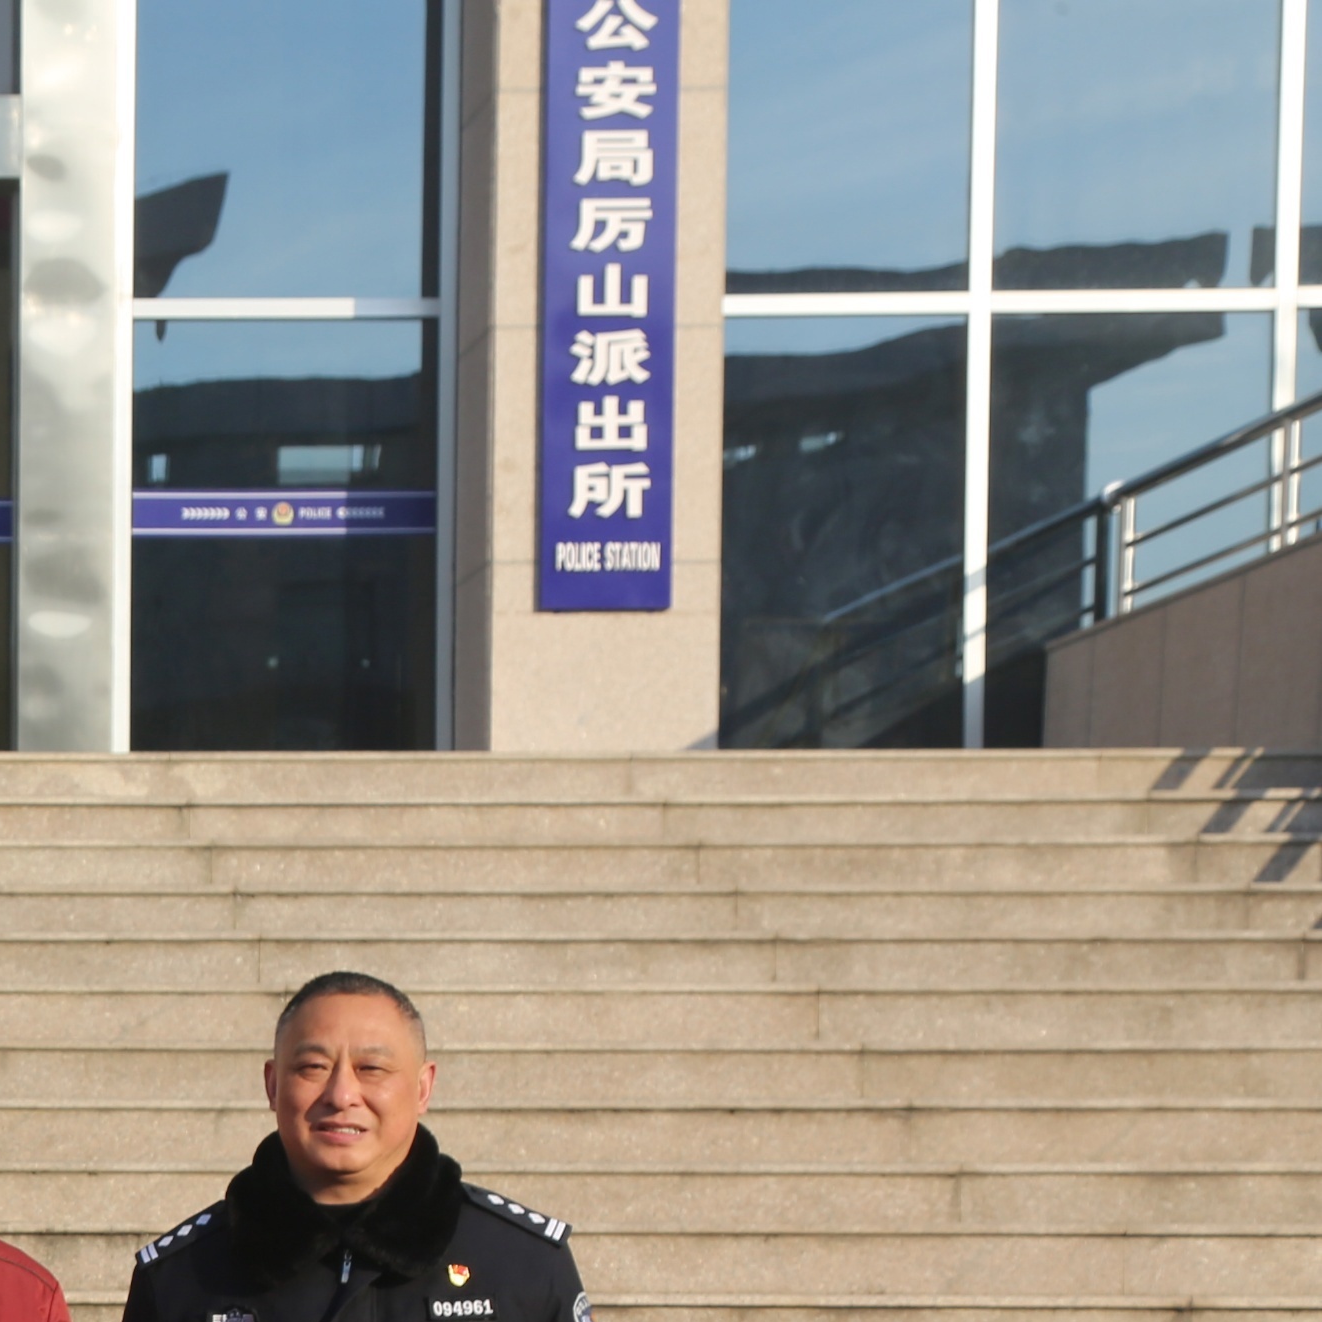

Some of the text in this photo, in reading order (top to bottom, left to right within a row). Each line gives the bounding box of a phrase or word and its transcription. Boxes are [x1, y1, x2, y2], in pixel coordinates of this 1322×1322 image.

[568, 0, 658, 520] 公安局厉山派出所
[298, 506, 332, 521] POLICE
[555, 541, 661, 572] POLICE STATION
[433, 1298, 494, 1317] 094961
